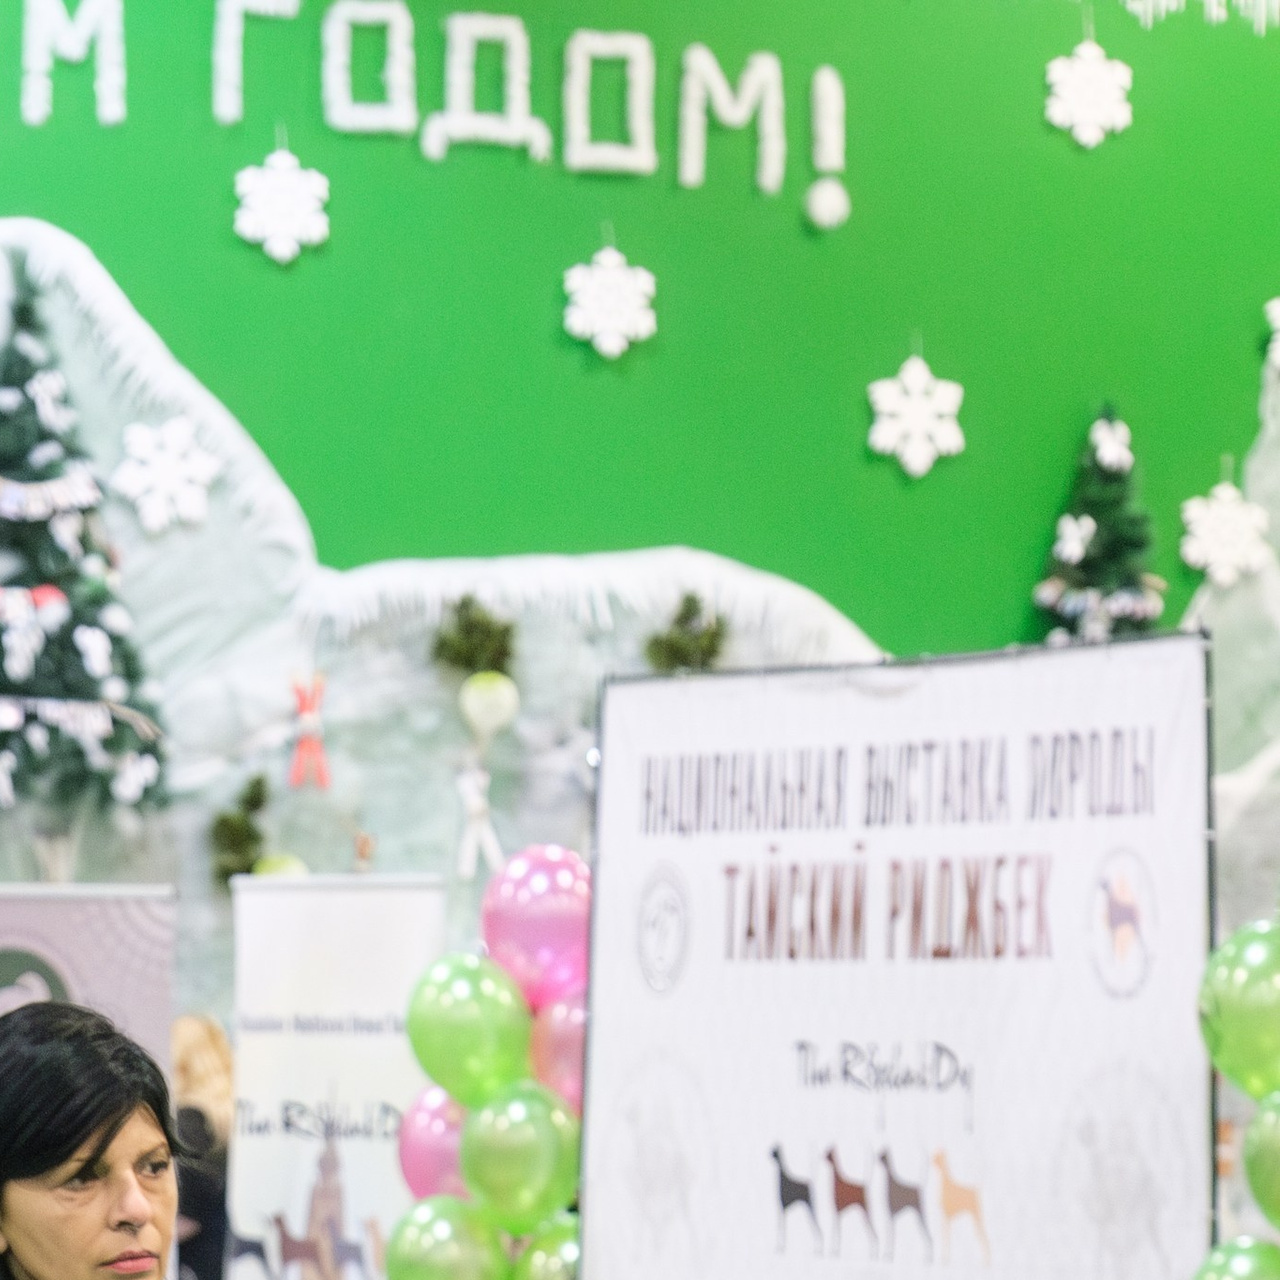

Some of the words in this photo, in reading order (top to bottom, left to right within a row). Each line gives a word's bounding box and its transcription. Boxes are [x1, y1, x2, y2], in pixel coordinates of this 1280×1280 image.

[212, 0, 851, 229] ГОДОМ!
[723, 840, 868, 962] ТАЙСКИЙ
[885, 854, 1053, 961] РИДЖБЕК
